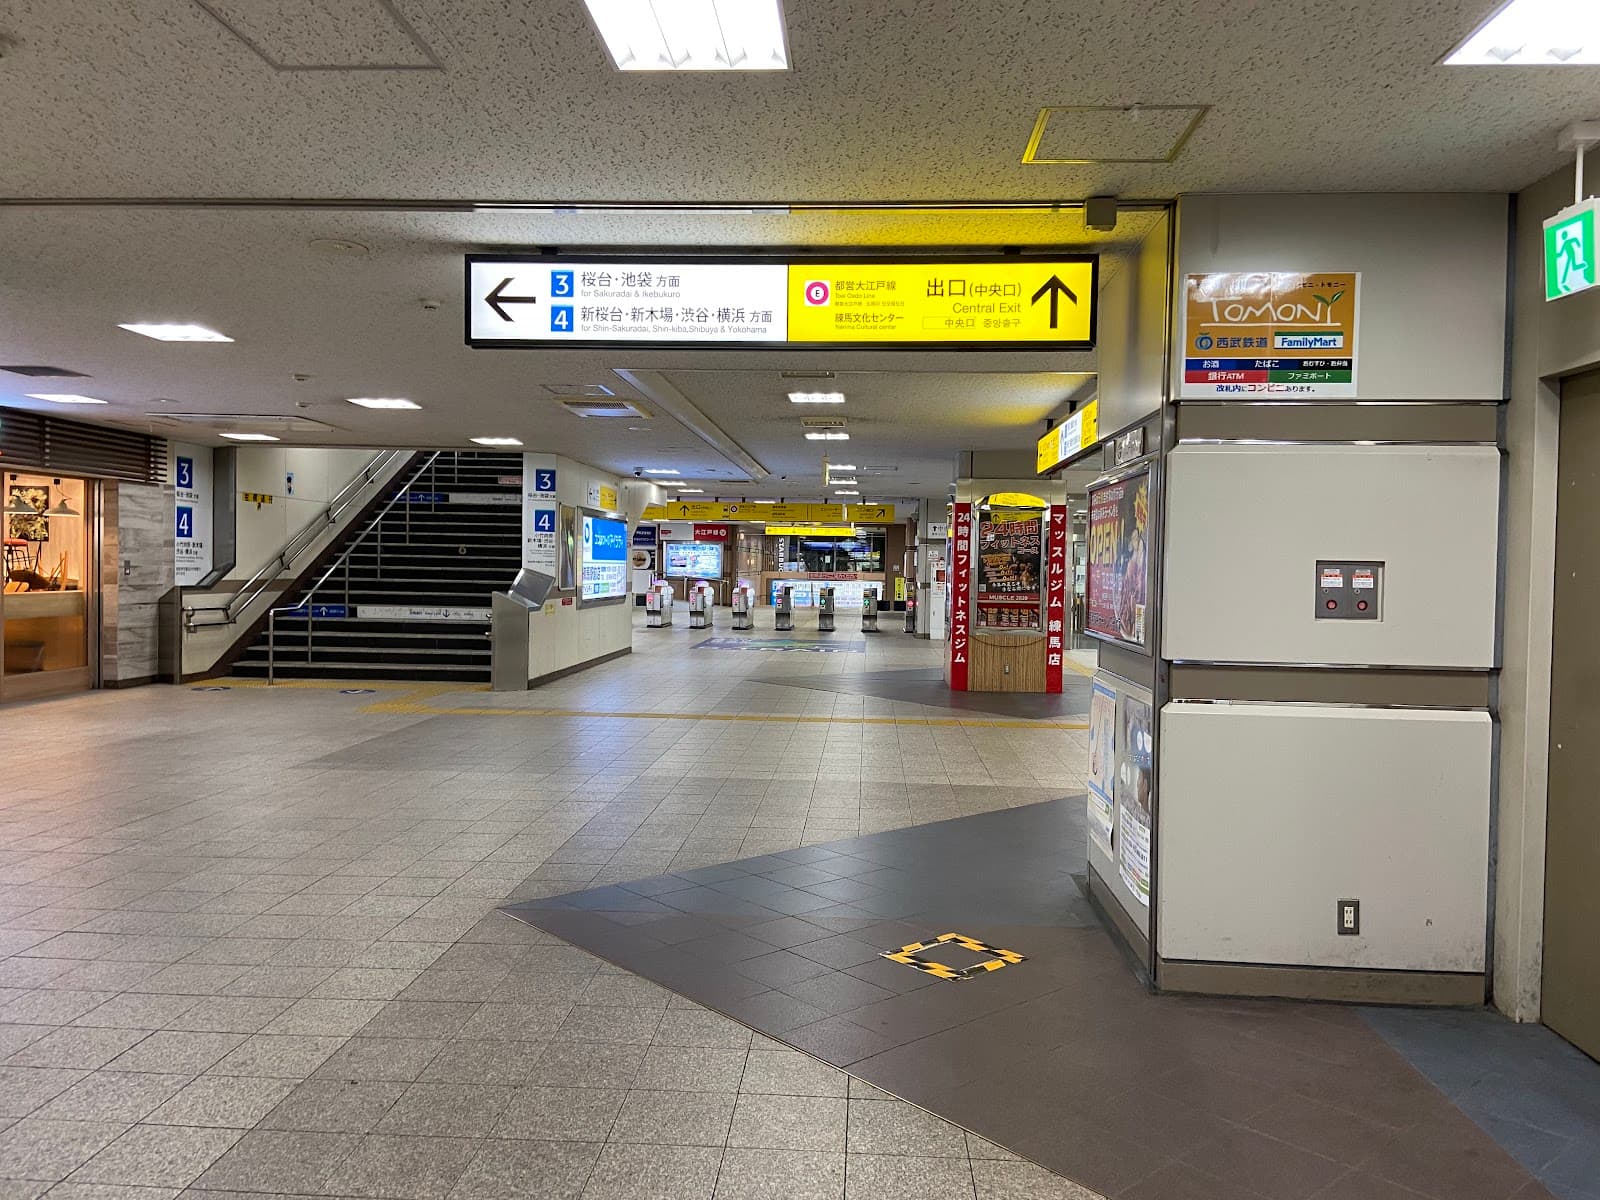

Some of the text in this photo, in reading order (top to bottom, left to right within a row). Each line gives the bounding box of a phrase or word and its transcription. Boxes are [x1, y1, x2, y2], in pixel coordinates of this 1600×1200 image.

[555, 274, 570, 295] 3
[581, 271, 680, 287] 桜台・池袋 方面
[835, 280, 896, 291] 都営大江戸線
[580, 306, 773, 323] 新桜台・新木場・渋谷・横浜 方面
[953, 302, 1021, 313] Central Exit
[553, 309, 569, 330] 4
[835, 313, 904, 323] 練馬文化センター
[581, 324, 591, 332] for
[728, 326, 767, 334] Yokohama
[1216, 337, 1268, 348] 西武鉄道
[1281, 336, 1337, 350] FamilyMart
[1202, 359, 1219, 369] お酒
[1254, 359, 1280, 368] たばこ
[1287, 372, 1331, 380] ファミポート
[180, 463, 189, 485] 3
[540, 473, 551, 489] 3
[179, 513, 189, 535] 4
[538, 514, 551, 530] 4
[980, 519, 1039, 538] 24時間
[980, 535, 1041, 550] フィットネス
[954, 512, 970, 663] 24時間フィットネスジム
[1048, 513, 1064, 666] マッスルジム 練馬店
